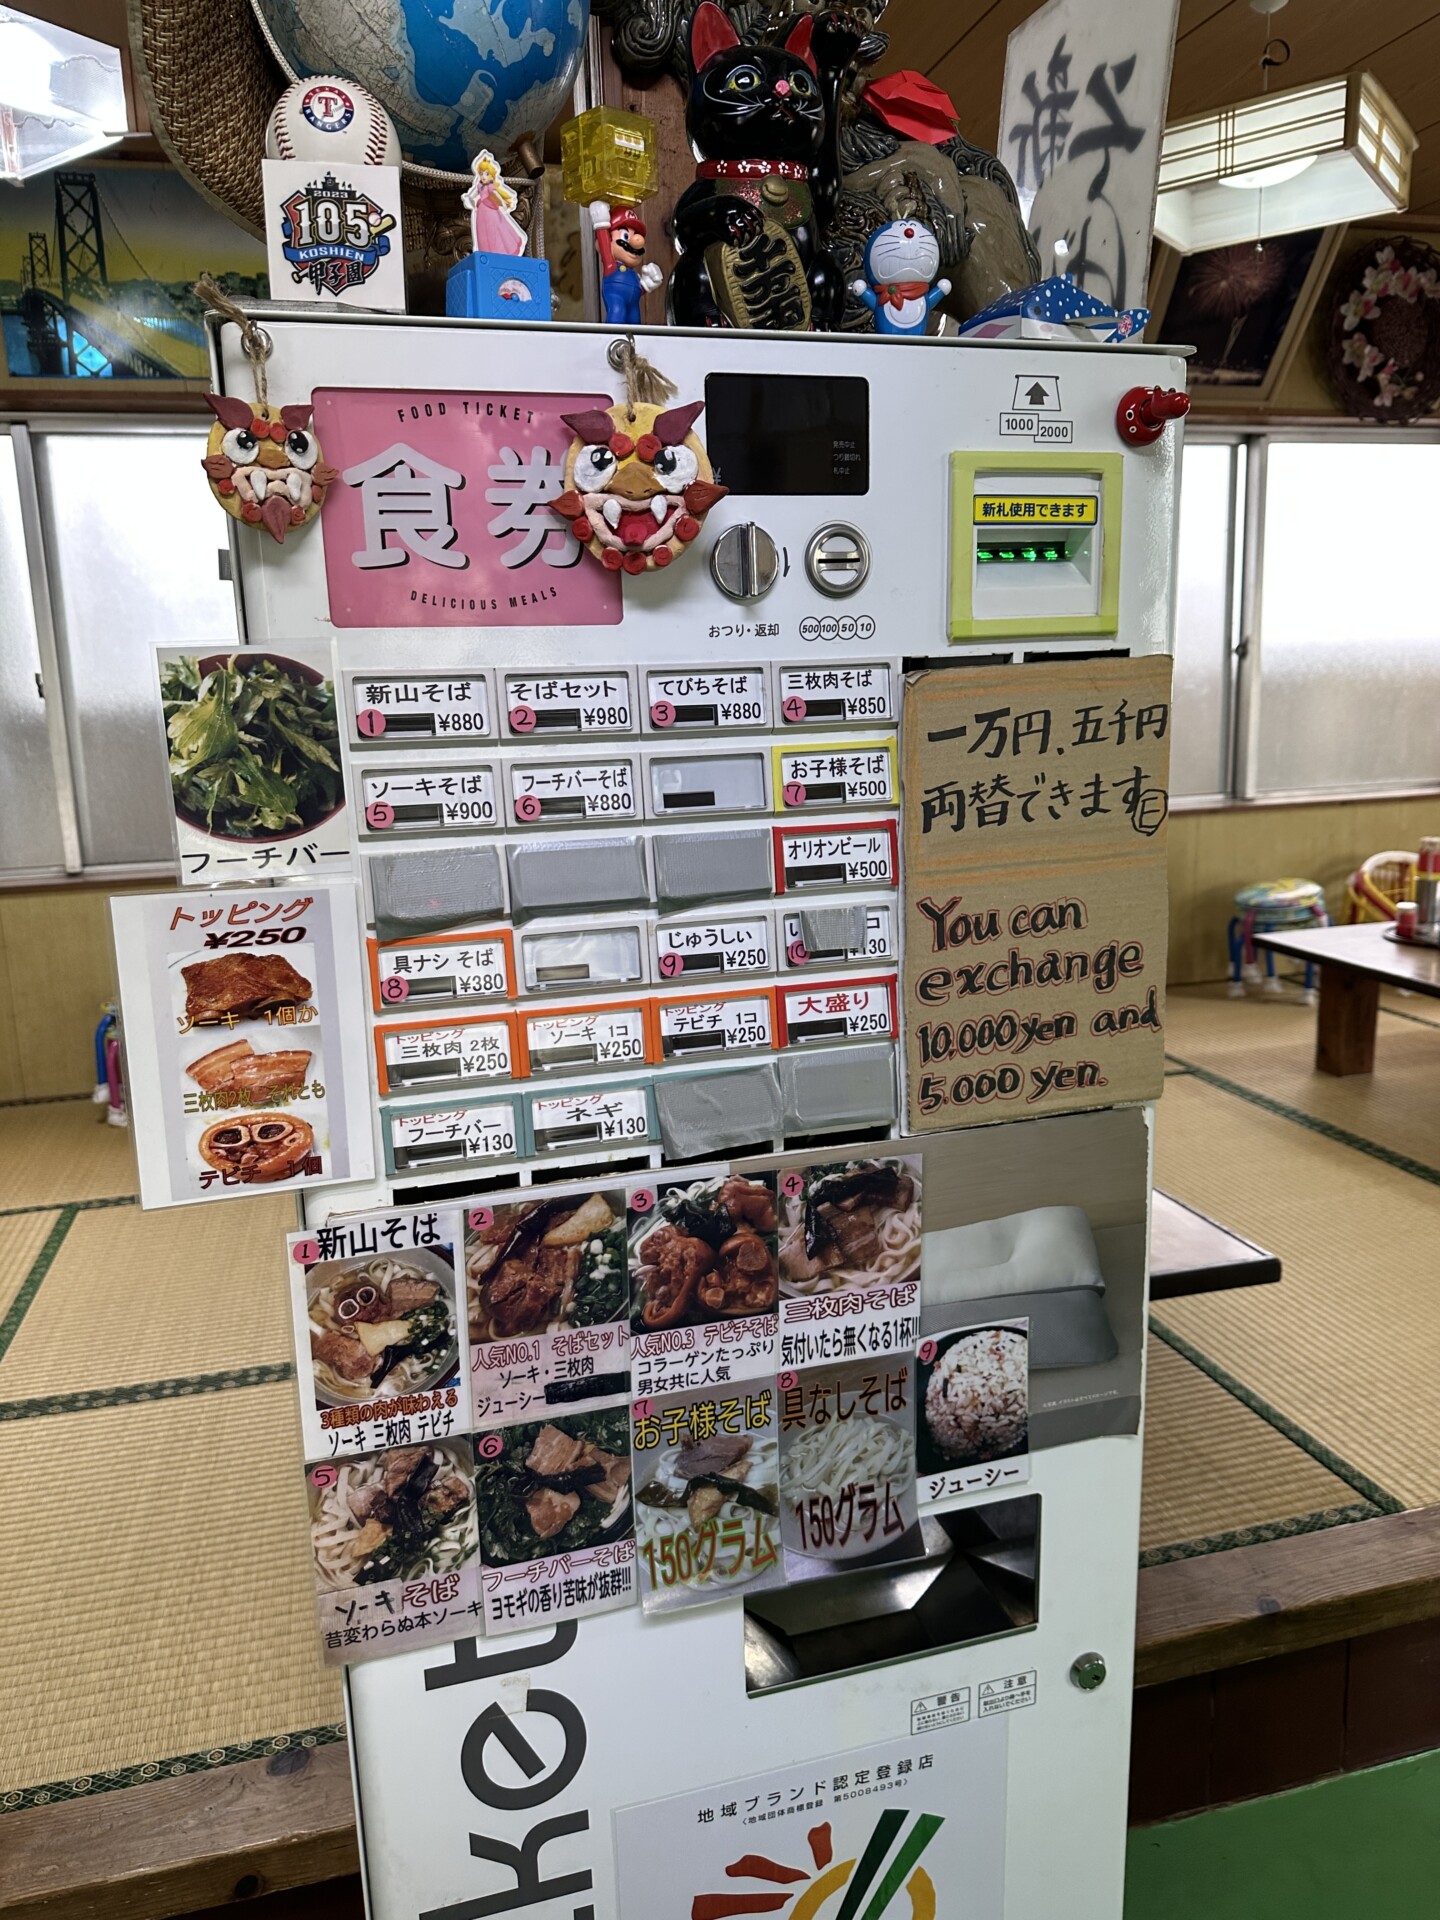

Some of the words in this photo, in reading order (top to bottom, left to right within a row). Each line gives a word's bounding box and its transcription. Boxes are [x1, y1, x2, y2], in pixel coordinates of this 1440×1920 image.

[305, 108, 352, 130] RANGERS
[313, 190, 349, 199] 2023
[294, 200, 373, 249] 105
[299, 246, 365, 262] KOSHIEN
[308, 261, 366, 295] 甲子園
[397, 402, 447, 422] FOOD
[463, 402, 534, 423] TICKET
[1005, 418, 1034, 432] 1000
[1040, 426, 1069, 440] 2000
[342, 442, 586, 570] 食券
[982, 502, 1088, 518] 新札使用できます
[410, 590, 497, 610] DELICIOUS
[509, 586, 558, 608] MEALS
[708, 623, 780, 638] おつり・返却
[802, 625, 819, 633] 500
[822, 624, 837, 633] 100
[841, 623, 854, 632] 50
[860, 622, 871, 632] 10
[658, 676, 748, 696] てびちそば
[788, 669, 873, 690] 三枚肉そば
[366, 682, 472, 704] 新山そば
[510, 680, 617, 701] そばセット
[655, 704, 669, 721] 3
[721, 702, 761, 720] ¥880
[786, 698, 802, 717] 4
[847, 696, 886, 715] ¥850
[367, 711, 375, 733] 1
[437, 712, 484, 732] ¥880
[516, 709, 532, 726] 2
[584, 707, 628, 726] ¥980
[791, 755, 884, 779] お子様そば
[371, 775, 483, 799] ソーキそば
[522, 767, 628, 793] フーチバーそば
[847, 780, 887, 797] ¥500
[587, 793, 632, 812] ¥880
[786, 784, 801, 802] 7
[921, 766, 1152, 834] 両替できます
[373, 804, 389, 822] 5
[446, 801, 493, 821] ¥900
[522, 797, 536, 815] 6
[181, 842, 350, 874] フーチバー
[788, 837, 881, 860] オリオンビール
[848, 860, 888, 879] ¥500
[169, 897, 314, 931] トッピング
[918, 898, 1001, 953] You
[1009, 898, 1087, 939] can
[204, 926, 307, 949] ¥250
[669, 928, 753, 948] じゅうしい
[726, 948, 767, 967] ¥250
[791, 943, 807, 960] 10
[663, 955, 676, 975] 9
[917, 941, 1144, 1005] exchange
[387, 979, 403, 999] 8
[459, 973, 504, 993] ¥380
[664, 1002, 727, 1017] トッピング
[798, 991, 870, 1016] 大盛り
[1091, 986, 1161, 1038] and
[176, 1011, 240, 1035] ソーキ
[264, 1004, 319, 1026] 1個か
[532, 1015, 599, 1030] トッピング
[674, 1014, 722, 1032] テビチ
[849, 1014, 888, 1032] ¥250
[395, 1028, 465, 1044] トッピング
[550, 1026, 597, 1044] ソーキ
[727, 1026, 766, 1044] ¥250
[401, 1041, 462, 1058] 三枚肉
[470, 1036, 501, 1051] 2枚
[599, 1038, 642, 1059] ¥250
[463, 1052, 508, 1073] ¥250
[537, 1094, 604, 1110] トッピング
[566, 1101, 623, 1122] ネギ
[398, 1109, 468, 1127] トッピング
[604, 1116, 646, 1137] ¥130
[408, 1119, 502, 1143] フーチバー
[468, 1133, 514, 1154] ¥130
[199, 1163, 262, 1189] テビチ
[785, 1176, 799, 1193] 4
[635, 1193, 648, 1208] 3
[475, 1211, 488, 1226] 2
[316, 1213, 441, 1261] 新山そば
[301, 1244, 310, 1259] 1
[784, 1283, 917, 1324] 三枚肉そば
[631, 1329, 695, 1360] 人気NO.3
[704, 1314, 779, 1346] テビチそば
[472, 1338, 541, 1372] 人気NO.1
[552, 1324, 630, 1354] そばセット
[638, 1339, 774, 1375] コラーゲンたっぷり
[919, 1343, 934, 1362] 9
[500, 1356, 594, 1389] ソーキ・三枚肉
[638, 1366, 731, 1396] 男女共に人気
[781, 1372, 793, 1388] 8
[321, 1388, 458, 1430] 3種類の肉が味わえる
[478, 1395, 546, 1418] ジューシー
[634, 1399, 649, 1415] 7
[782, 1367, 908, 1430] 具なしそば
[634, 1389, 771, 1450] お子様そば
[328, 1429, 365, 1456] ソーキ
[374, 1421, 412, 1447] 三枚肉
[418, 1411, 455, 1440] テビチ
[483, 1436, 499, 1455] 6
[314, 1468, 334, 1487] 5
[929, 1466, 1020, 1499] ジューシー
[796, 1481, 905, 1551] 150グラム
[643, 1517, 778, 1592] 150グラム
[481, 1540, 636, 1592] フーチバーそば
[401, 1574, 460, 1609] そば
[492, 1567, 633, 1620] ヨモギの香り苦味が抜群!!!
[325, 1600, 483, 1649] 昔変わらぬ本ソーキ
[418, 1618, 594, 1920] ket
[697, 1753, 934, 1824] 地域ブランド認定登録店
